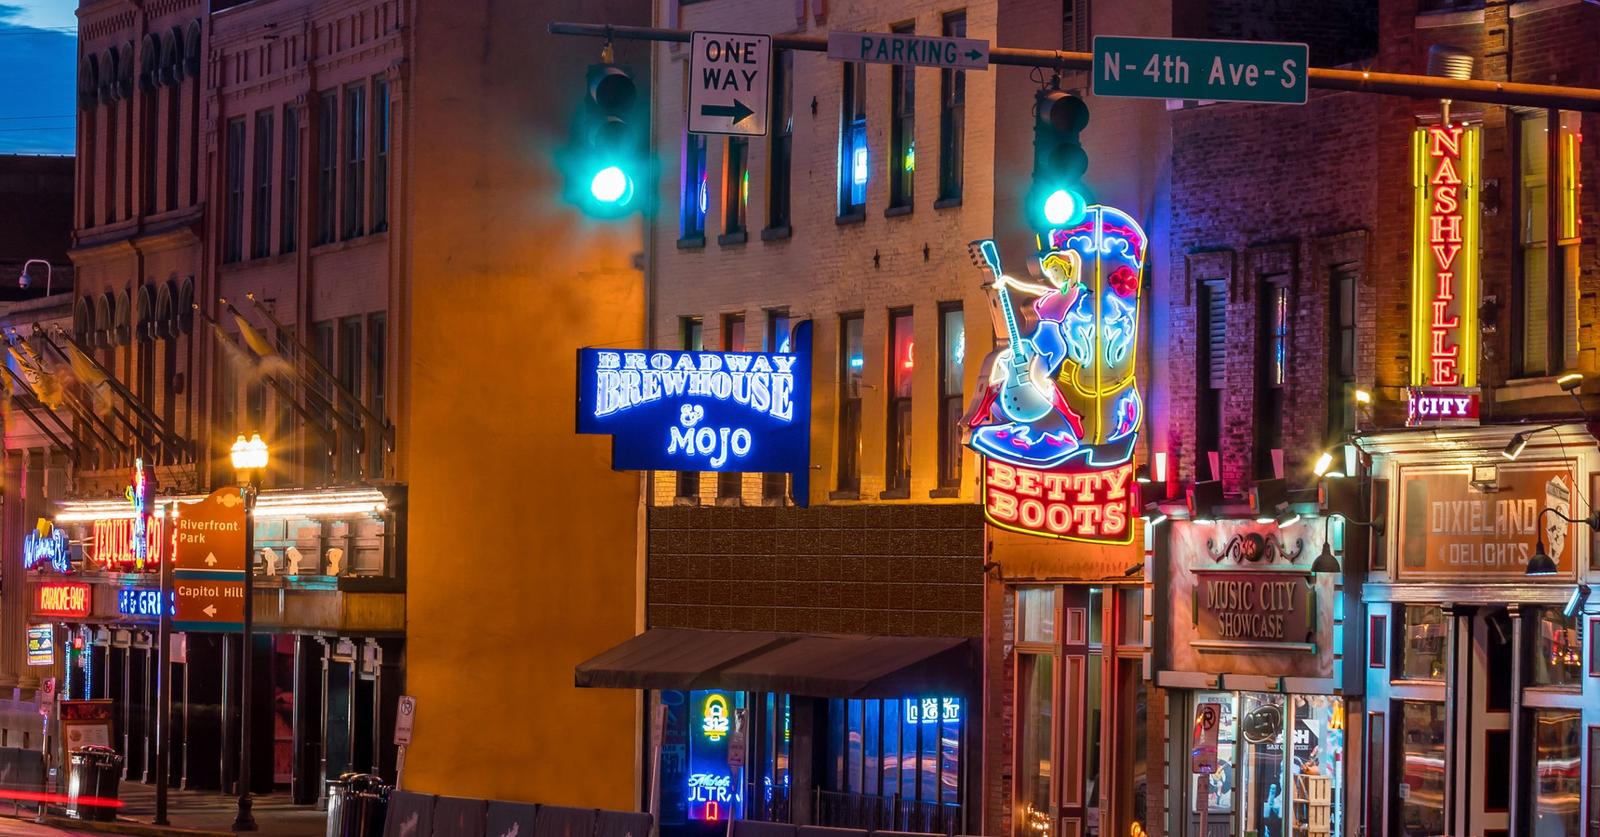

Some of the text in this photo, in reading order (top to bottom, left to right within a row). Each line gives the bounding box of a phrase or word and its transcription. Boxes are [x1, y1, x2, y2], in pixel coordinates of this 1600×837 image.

[705, 40, 757, 64] ONE
[860, 37, 957, 63] PARKING
[703, 68, 758, 91] WAY
[1430, 128, 1463, 386] NASHVILLE
[597, 351, 797, 373] BROADWAY
[594, 369, 794, 423] BREWHOUSE
[1418, 397, 1470, 415] CITY
[680, 404, 704, 427] &
[667, 427, 751, 468] MOJO
[987, 460, 1133, 502] BETTY
[180, 519, 239, 531] Riverfront
[987, 488, 1127, 536] BOOTS
[1431, 498, 1538, 537] DIXIELAND
[180, 532, 206, 544] Park
[1449, 542, 1529, 568] DELIGHTS
[178, 586, 244, 599] Capitol Hill
[1207, 580, 1297, 611] MUSIC CITY
[1218, 612, 1284, 638] SHOWCASE
